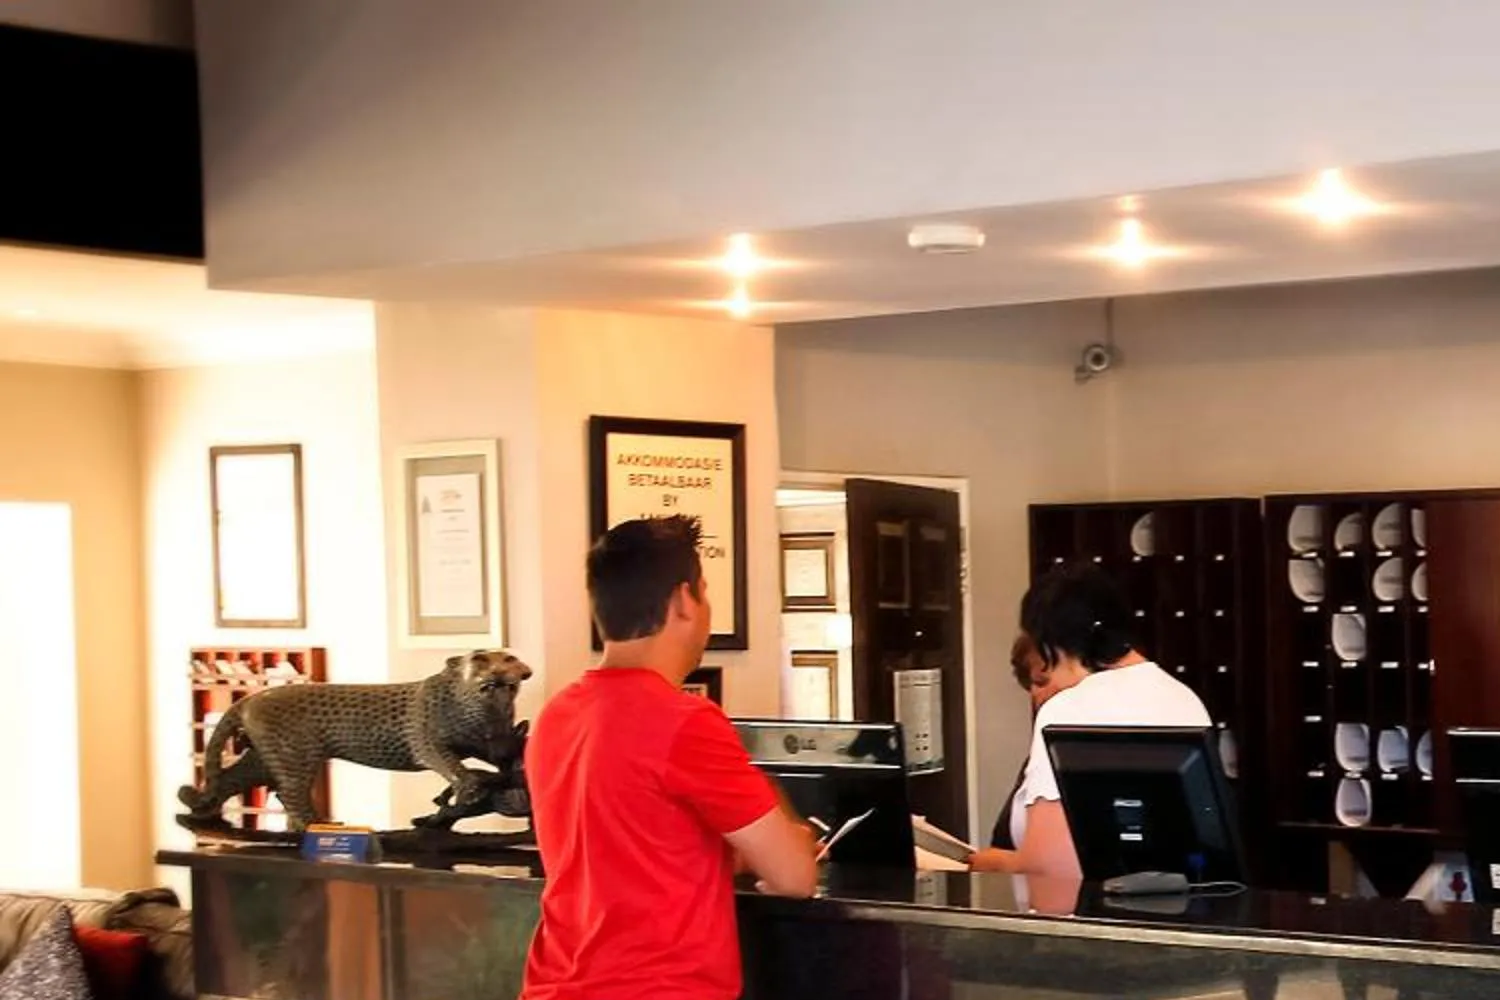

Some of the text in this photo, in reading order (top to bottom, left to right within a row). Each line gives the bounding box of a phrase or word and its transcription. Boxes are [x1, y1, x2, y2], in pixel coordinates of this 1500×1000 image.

[616, 453, 723, 471] AKKOMMODASIE
[627, 472, 712, 490] BETAALBAAR
[662, 493, 679, 507] BY
